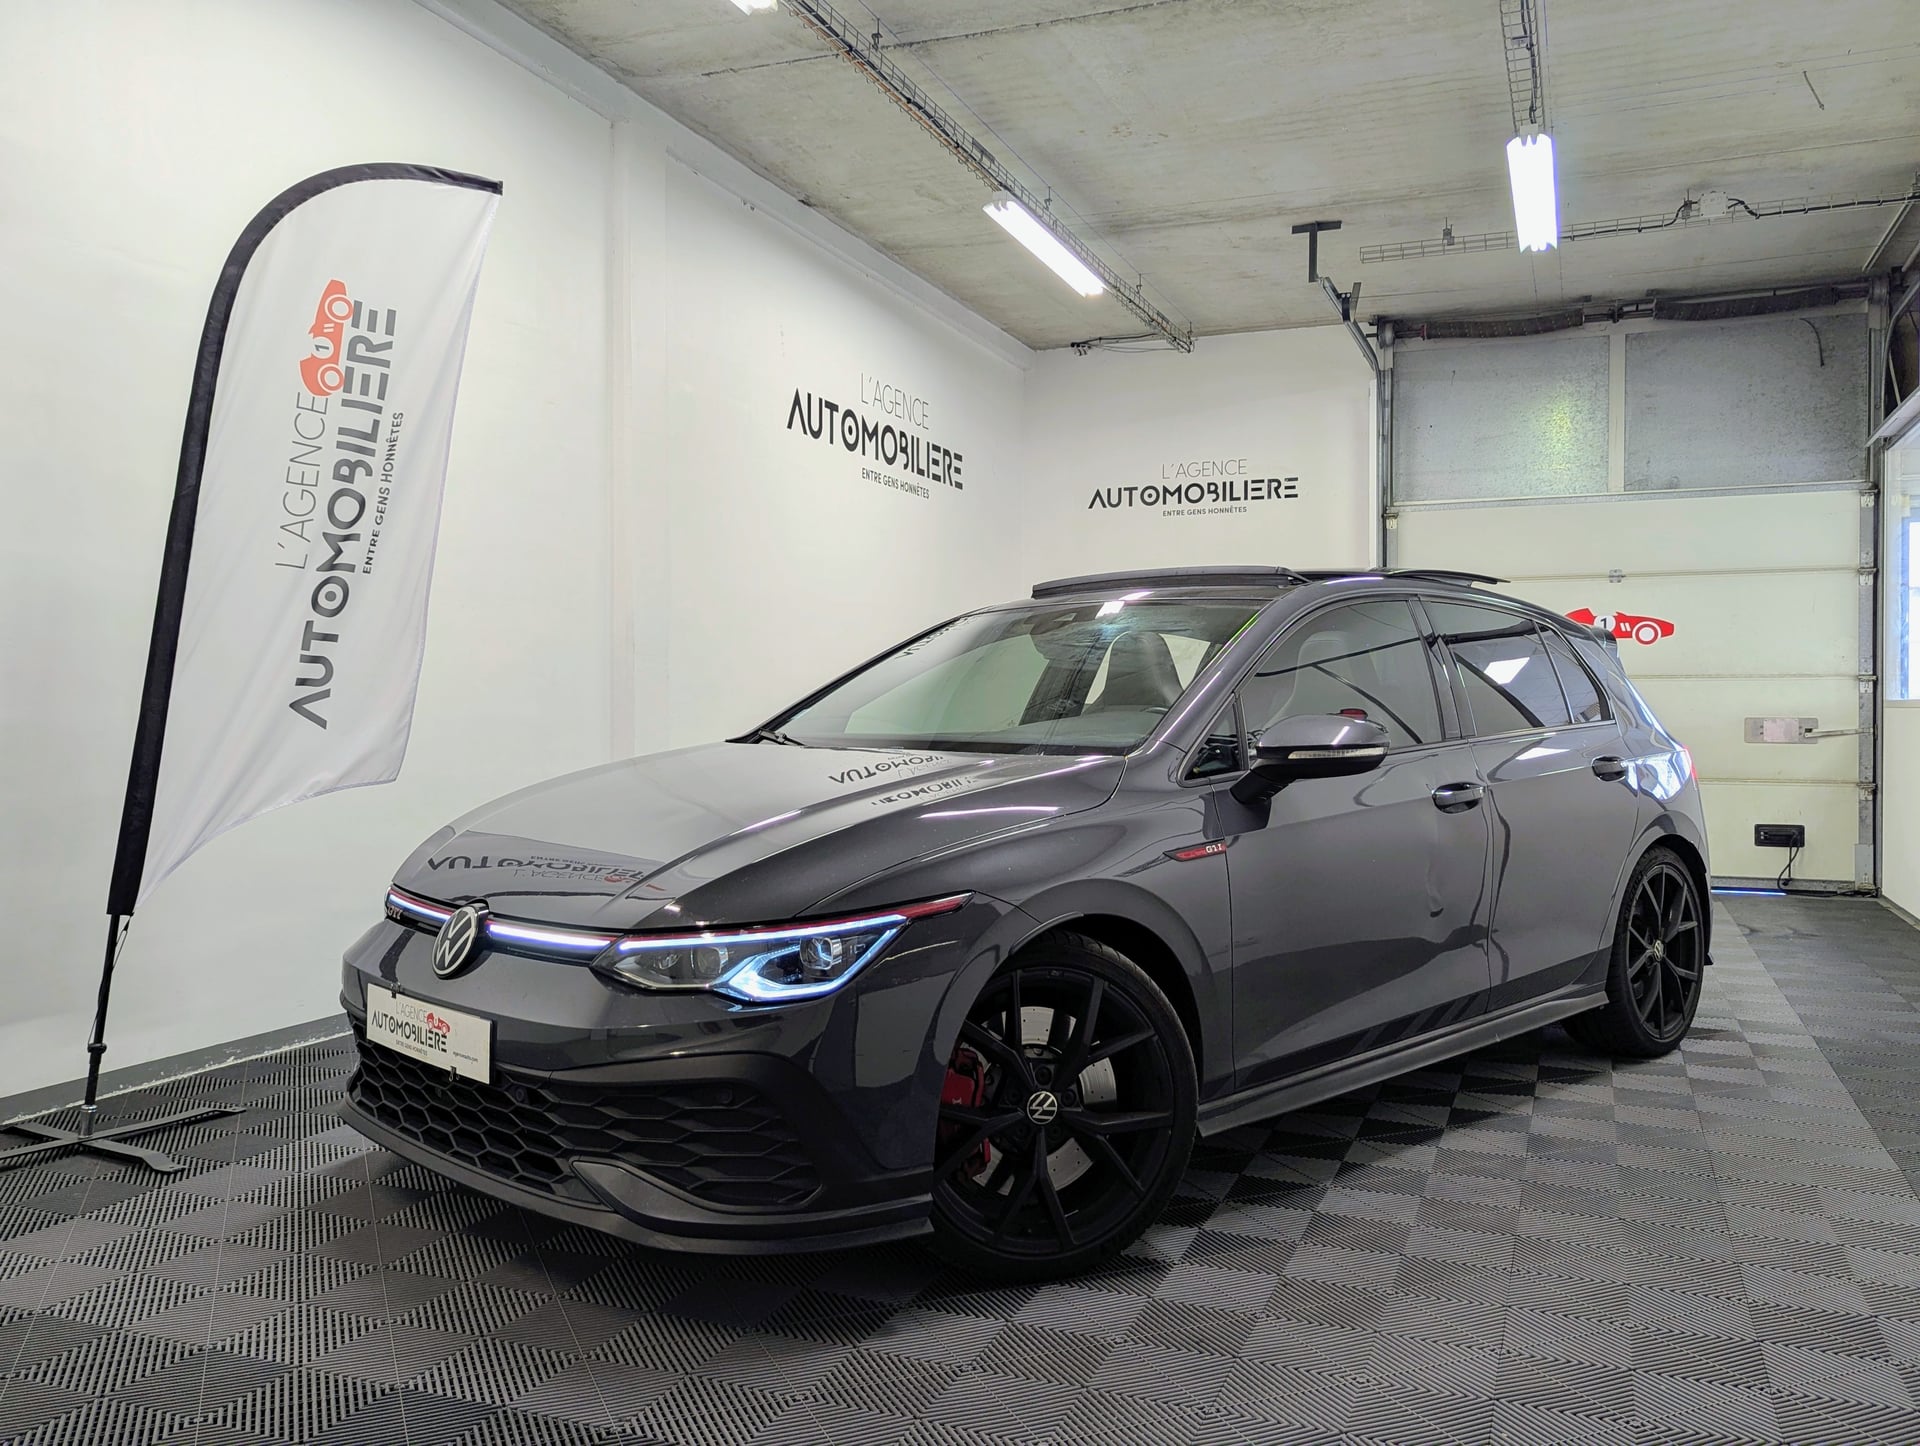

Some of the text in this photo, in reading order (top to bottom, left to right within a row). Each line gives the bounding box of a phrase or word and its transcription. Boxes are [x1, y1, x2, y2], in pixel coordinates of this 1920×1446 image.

[860, 372, 929, 430] L'AGENCE
[786, 387, 963, 490] AUTOMOBILIERE
[275, 391, 329, 570] L'AGENCE
[861, 467, 930, 500] ENTRE GENS HONNÊTES
[1161, 458, 1248, 480] L'AGENCE
[362, 411, 404, 575] ENTRE GENS HONNÊTES
[1087, 476, 1299, 509] AUTOMOBILIERE
[1162, 505, 1248, 517] ENTRE GENS HONNÊTES
[288, 299, 397, 730] AUTOMOBILIERE
[1600, 617, 1607, 629] 1
[1205, 843, 1223, 853] GTI
[371, 1010, 448, 1053] AUTOMOBILIERE
